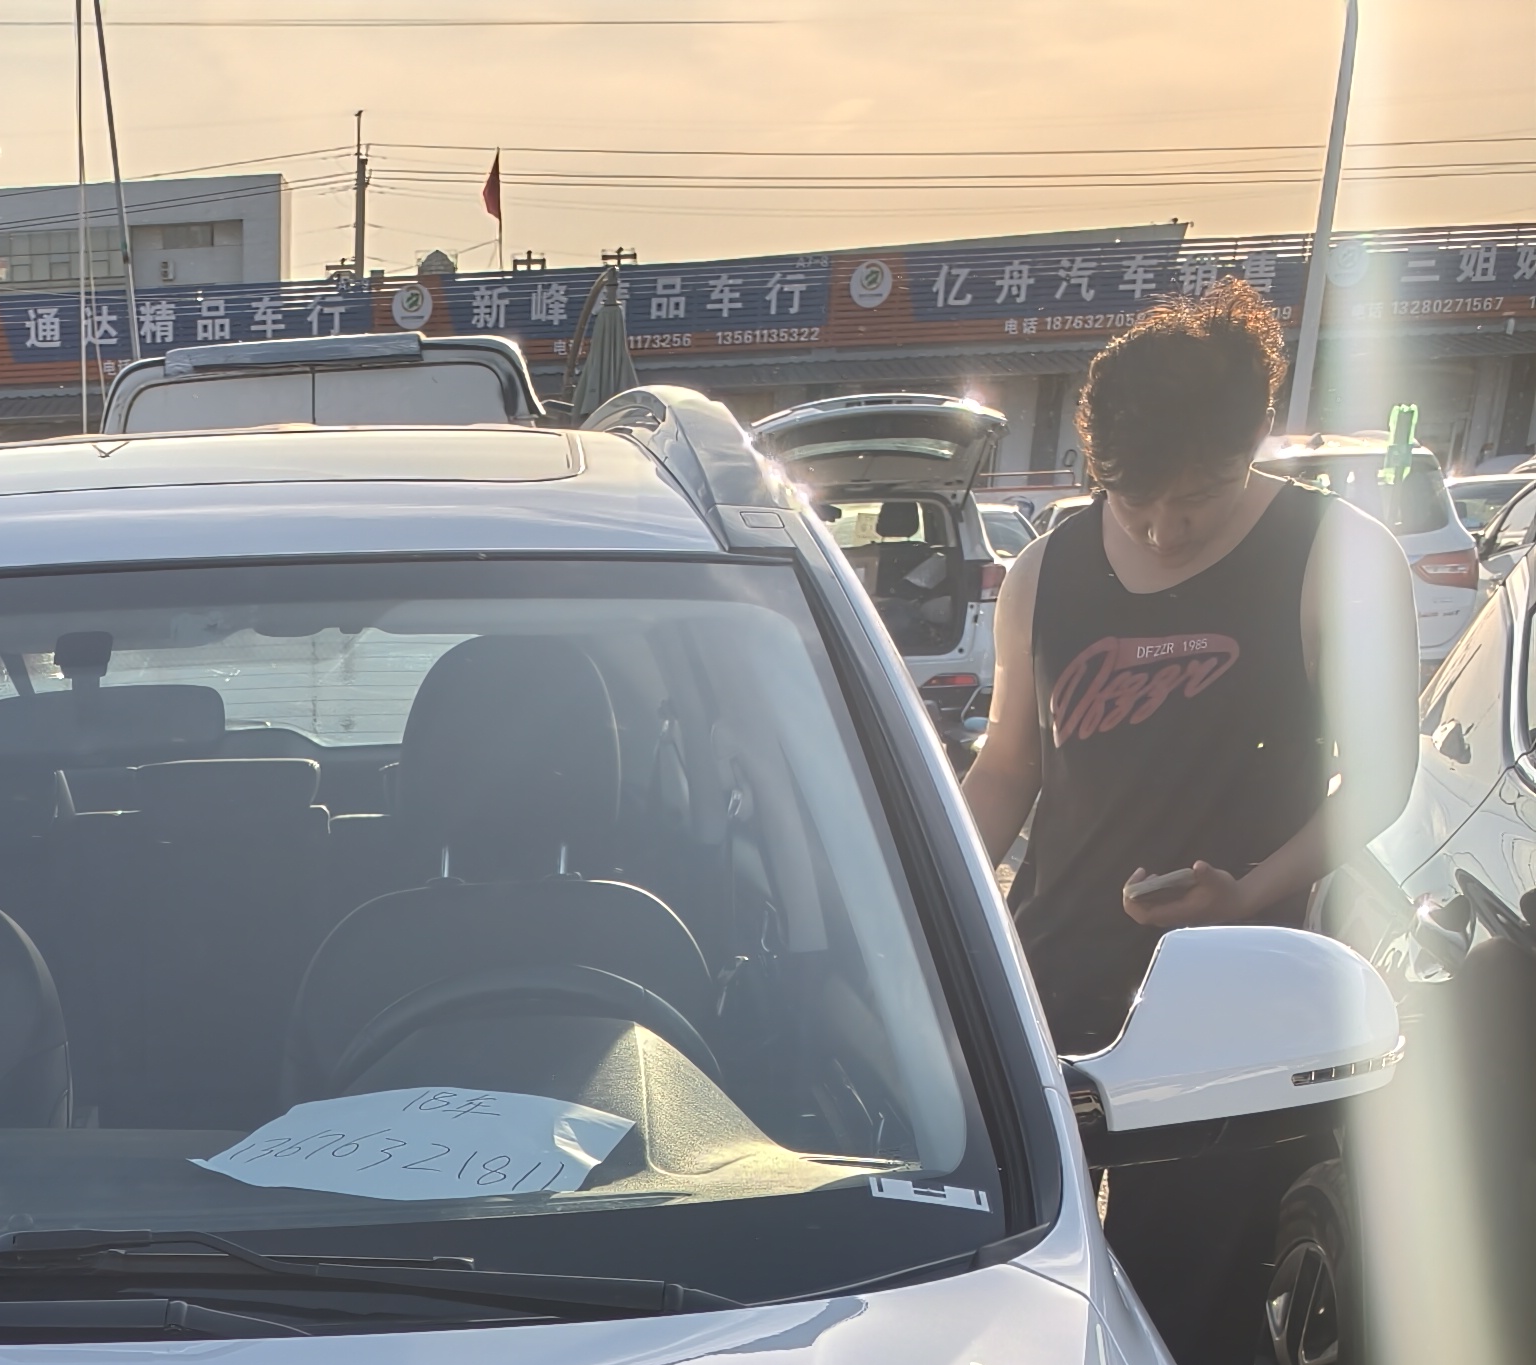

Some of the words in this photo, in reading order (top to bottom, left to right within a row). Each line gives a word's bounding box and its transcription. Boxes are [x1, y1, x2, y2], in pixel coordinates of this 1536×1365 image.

[932, 252, 1277, 307] 亿舟汽车销售
[471, 273, 808, 328] 新峰品车行
[1391, 297, 1505, 315] 13280271567
[24, 296, 346, 348] 通达精品车行
[1005, 317, 1038, 335] 电话
[716, 327, 820, 345] 13561135322
[1182, 638, 1208, 652] 1985
